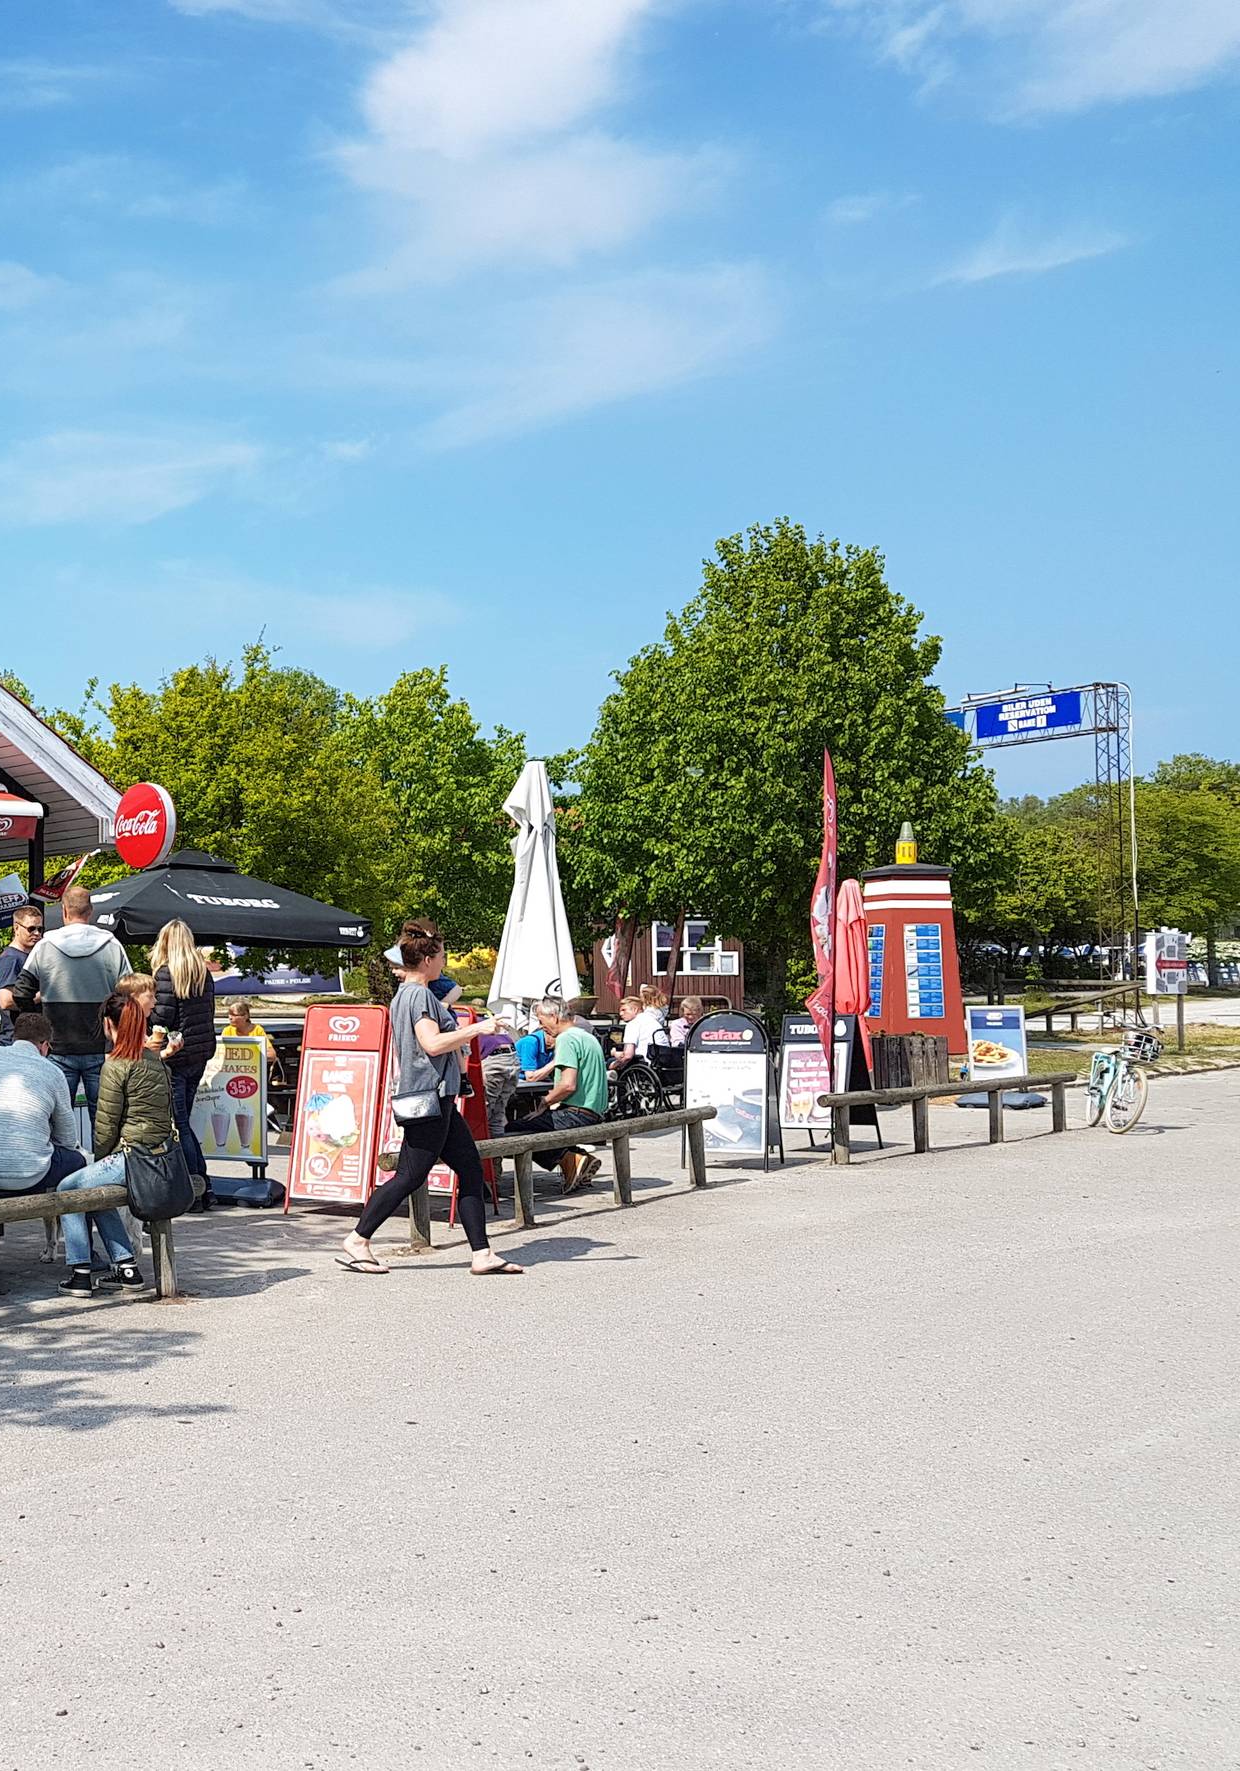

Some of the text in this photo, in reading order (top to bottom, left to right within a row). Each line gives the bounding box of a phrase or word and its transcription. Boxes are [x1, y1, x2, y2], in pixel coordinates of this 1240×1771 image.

[998, 705, 1056, 721] RESERVATION
[116, 809, 161, 839] Coca-Cola
[187, 893, 280, 910] TUBORG
